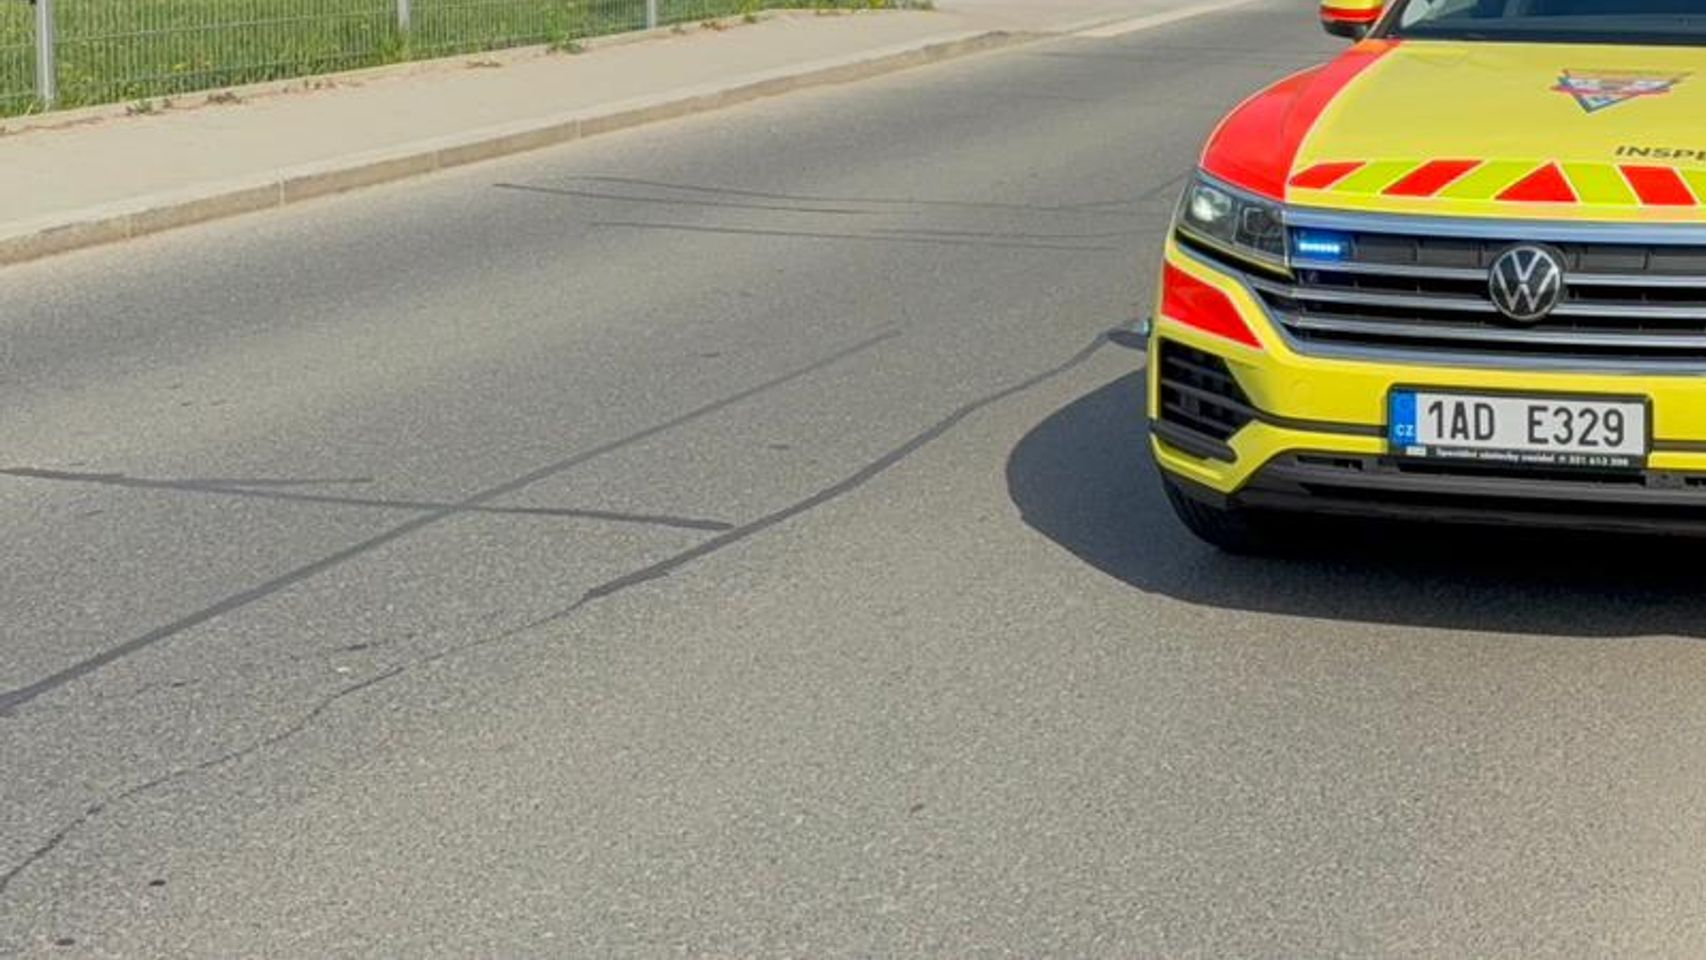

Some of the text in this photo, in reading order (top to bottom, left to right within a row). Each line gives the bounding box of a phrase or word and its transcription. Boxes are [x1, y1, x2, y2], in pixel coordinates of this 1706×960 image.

[1395, 424, 1414, 437] CZ
[1428, 401, 1625, 448] 1AD E329
